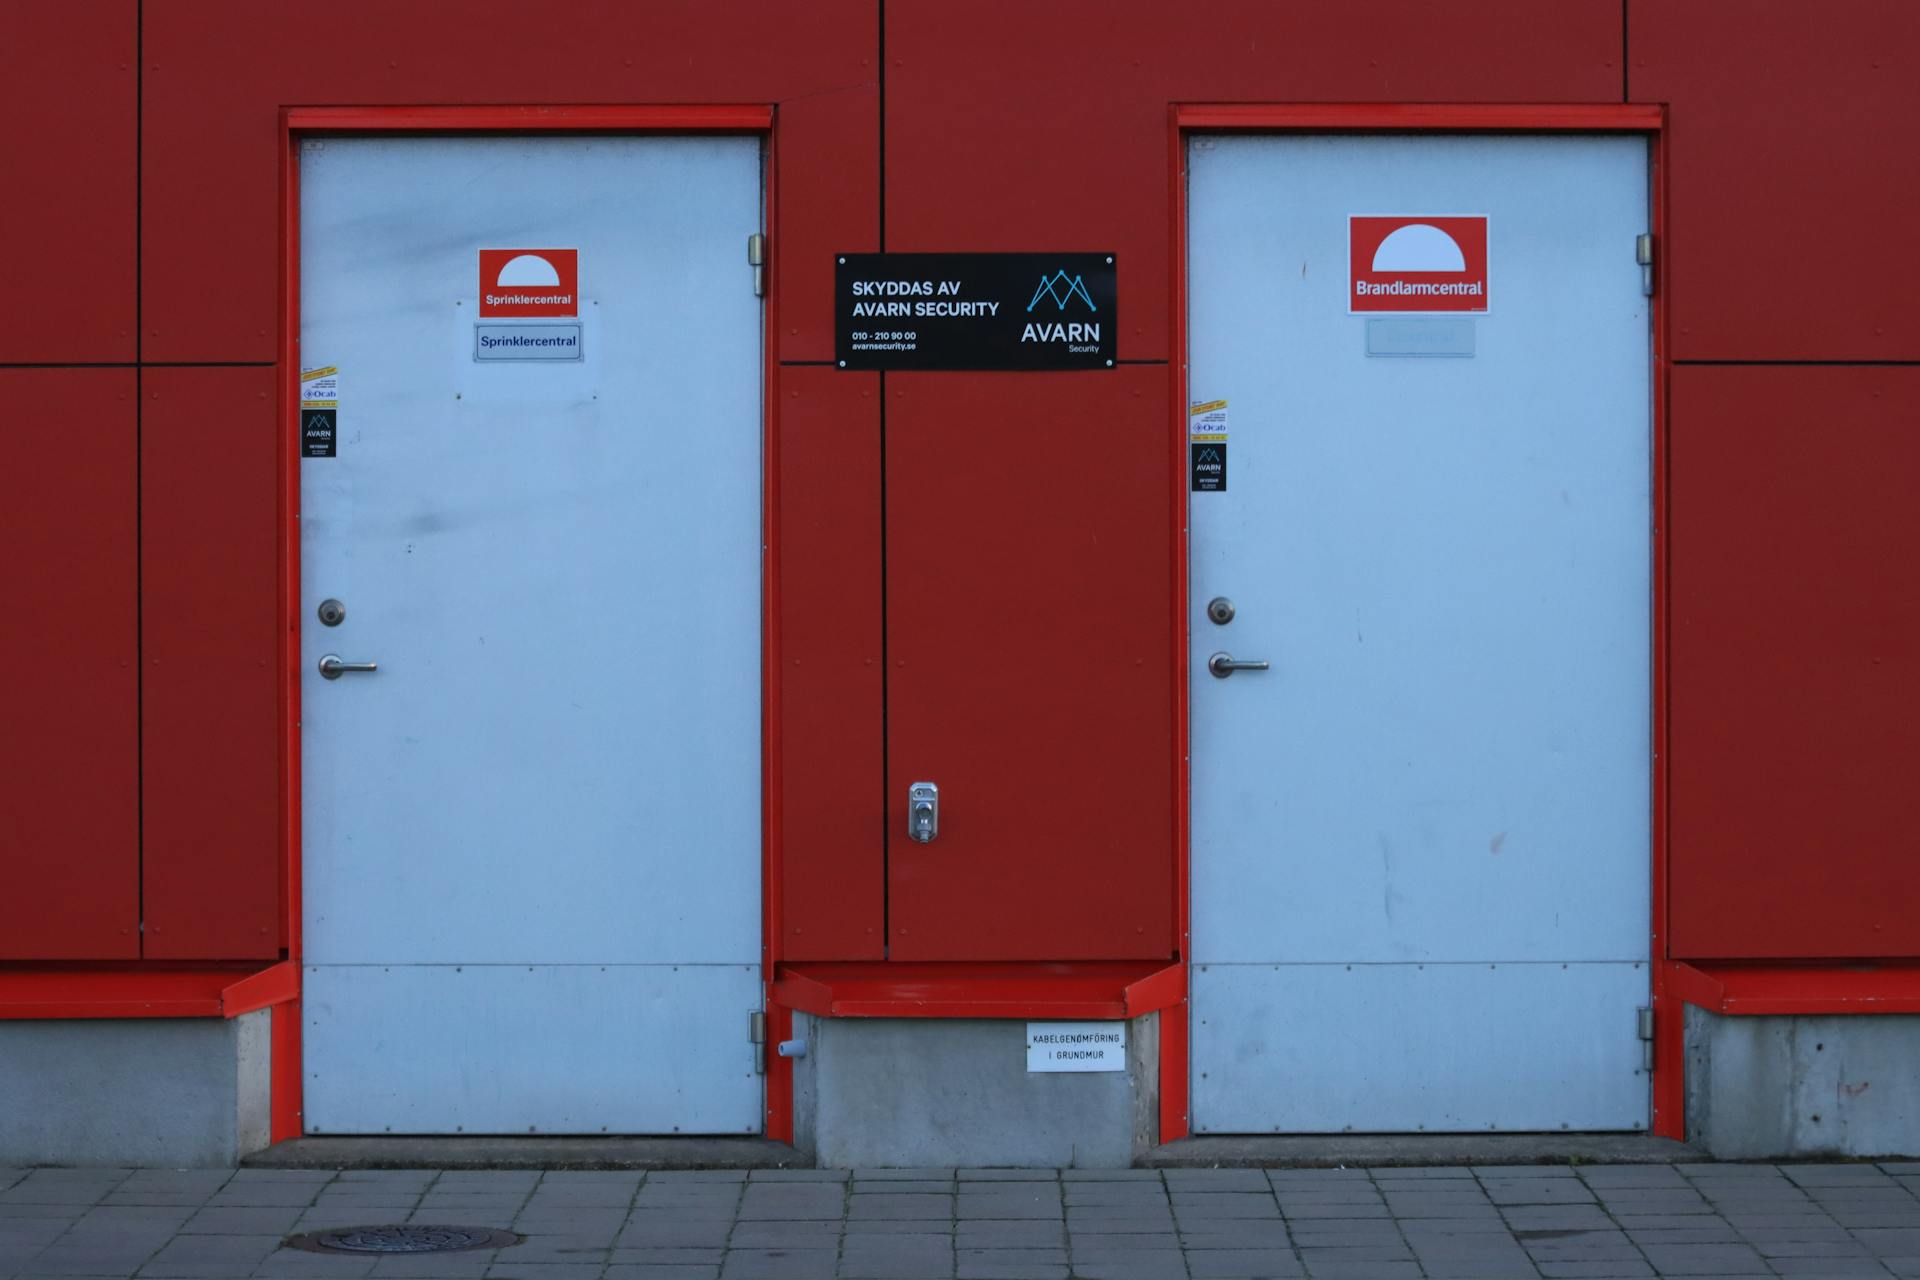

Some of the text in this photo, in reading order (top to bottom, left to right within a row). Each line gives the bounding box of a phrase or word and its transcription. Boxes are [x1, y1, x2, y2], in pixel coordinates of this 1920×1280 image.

[852, 281, 961, 296] SKYDDAS AV
[1356, 280, 1483, 296] Brandlarmcentral
[486, 294, 571, 306] Sprinklercentral
[852, 302, 1000, 317] AVARN SECURITY
[852, 332, 868, 340] 010
[874, 332, 890, 340] 210
[891, 332, 903, 340] 90
[904, 332, 916, 340] 00
[1021, 323, 1100, 342] AVARN
[481, 335, 576, 348] Sprinklercentral
[852, 343, 916, 351] avarnsecurity.se
[1068, 344, 1100, 354] Security
[1056, 1050, 1105, 1060] GRUNDMUR
